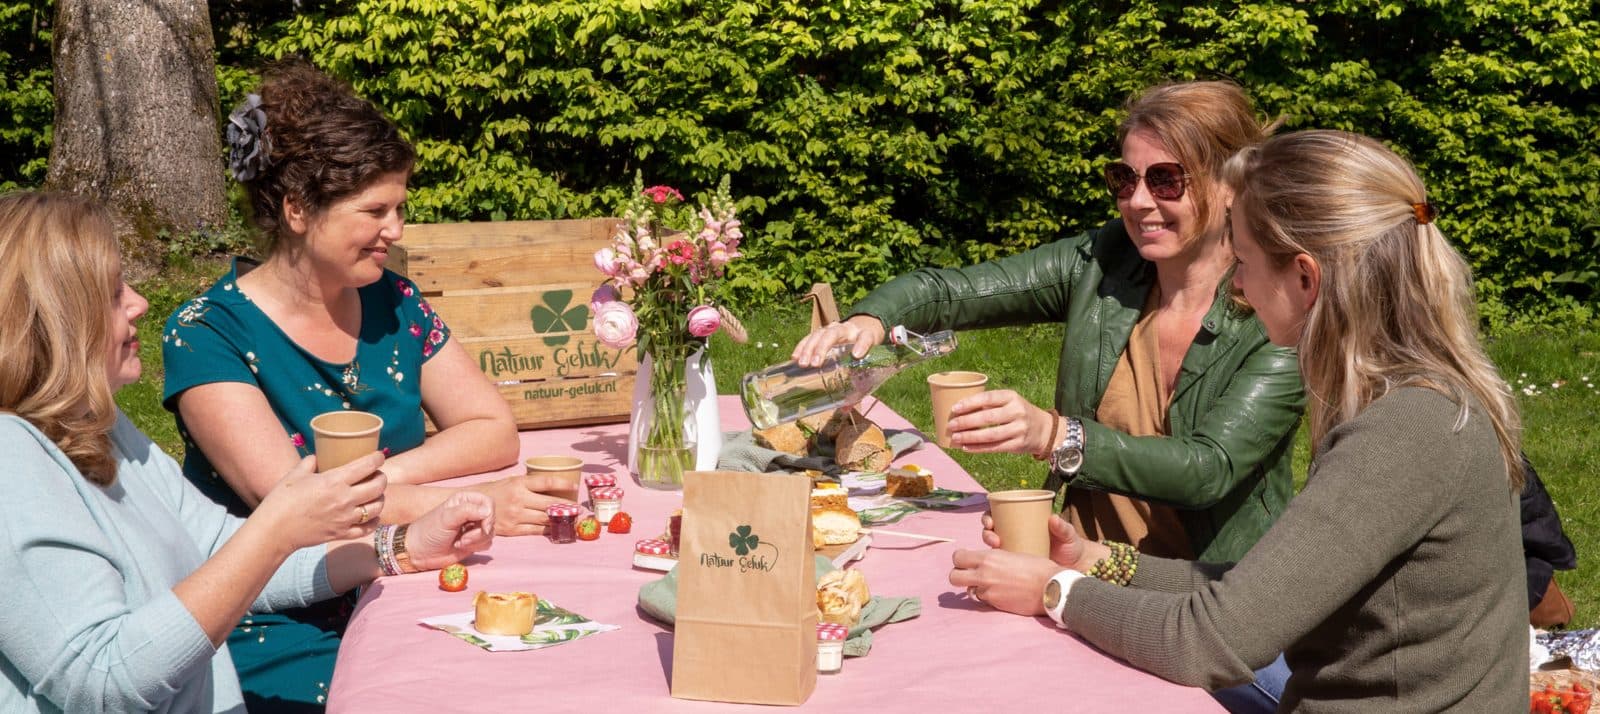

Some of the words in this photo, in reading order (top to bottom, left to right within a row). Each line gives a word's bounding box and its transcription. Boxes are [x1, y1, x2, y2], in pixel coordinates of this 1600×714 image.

[480, 346, 544, 376] Natuur
[553, 341, 620, 376] Geluk
[524, 381, 616, 400] natuur-geluk.nl
[700, 552, 734, 568] Natuur
[739, 555, 770, 573] Geluk
